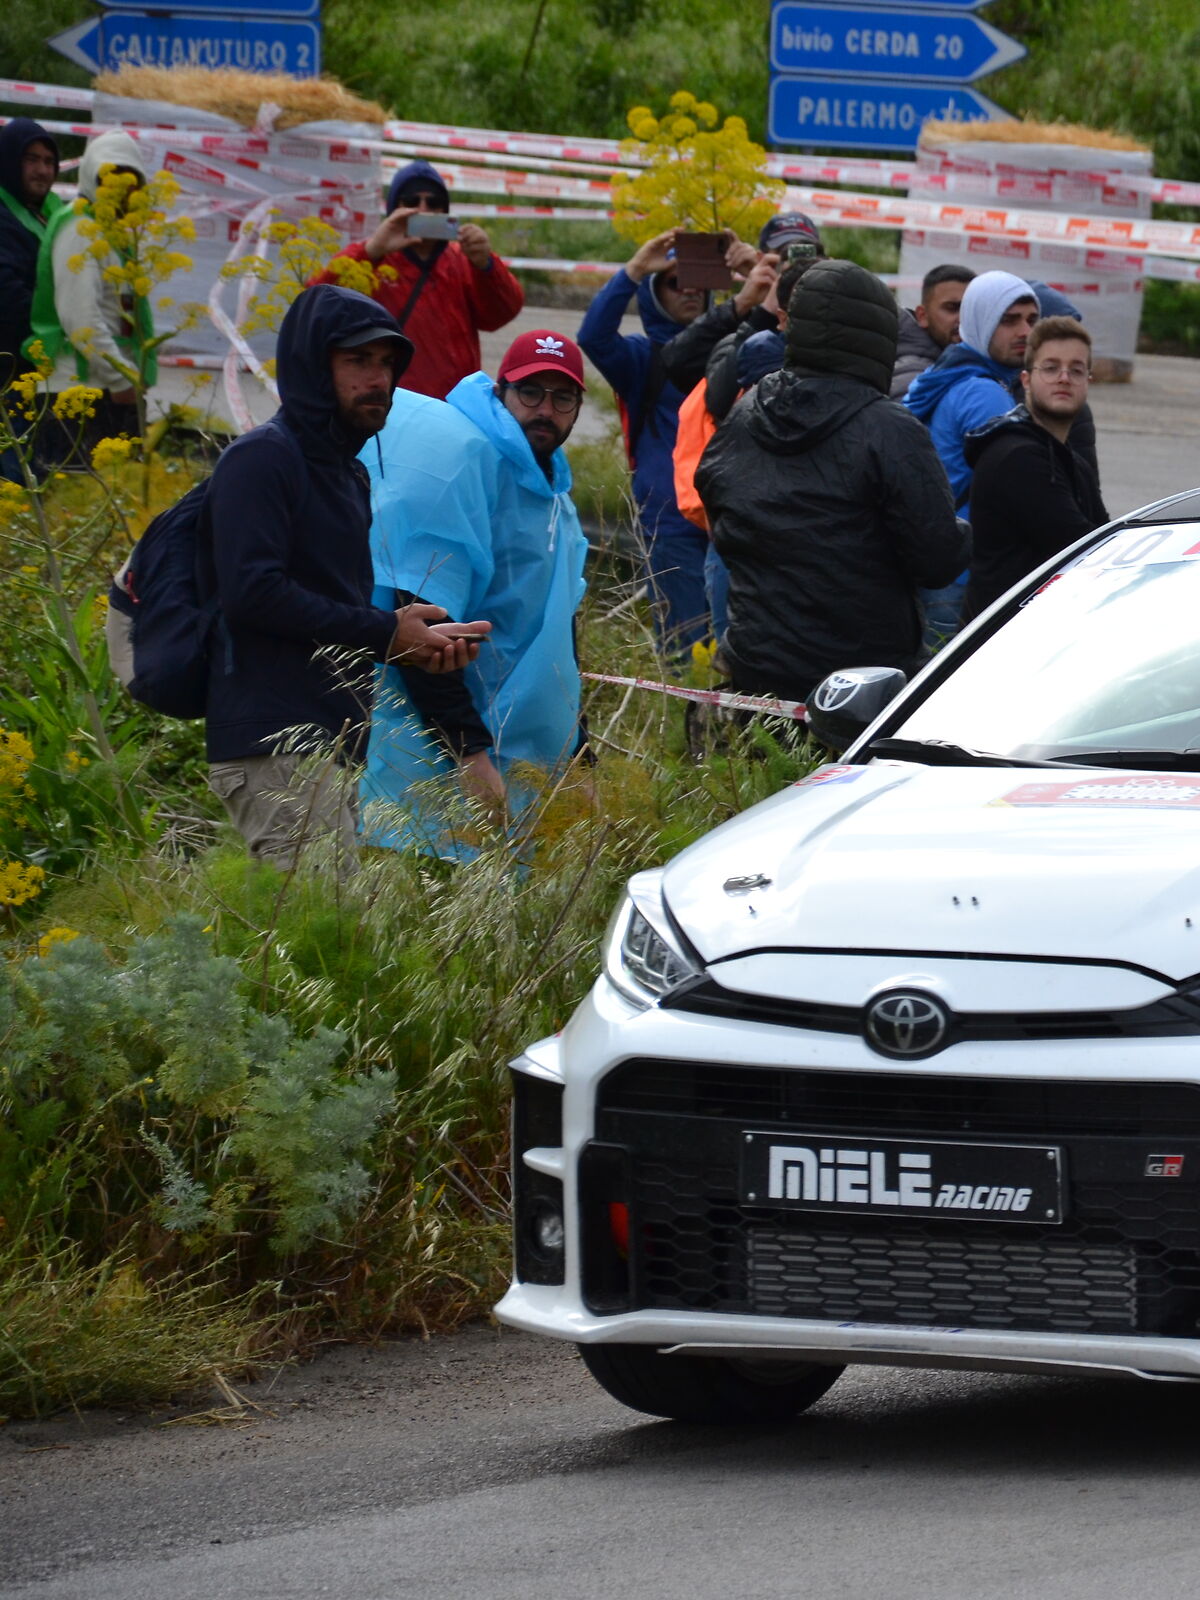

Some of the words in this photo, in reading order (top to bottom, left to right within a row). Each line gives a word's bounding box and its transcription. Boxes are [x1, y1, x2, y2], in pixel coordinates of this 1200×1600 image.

[782, 25, 833, 52] bivio
[845, 29, 919, 58] CERDA
[934, 35, 964, 60] 20
[296, 43, 310, 68] 2
[798, 96, 916, 130] PALERMO
[535, 348, 565, 358] adidas
[1146, 1161, 1181, 1176] GR
